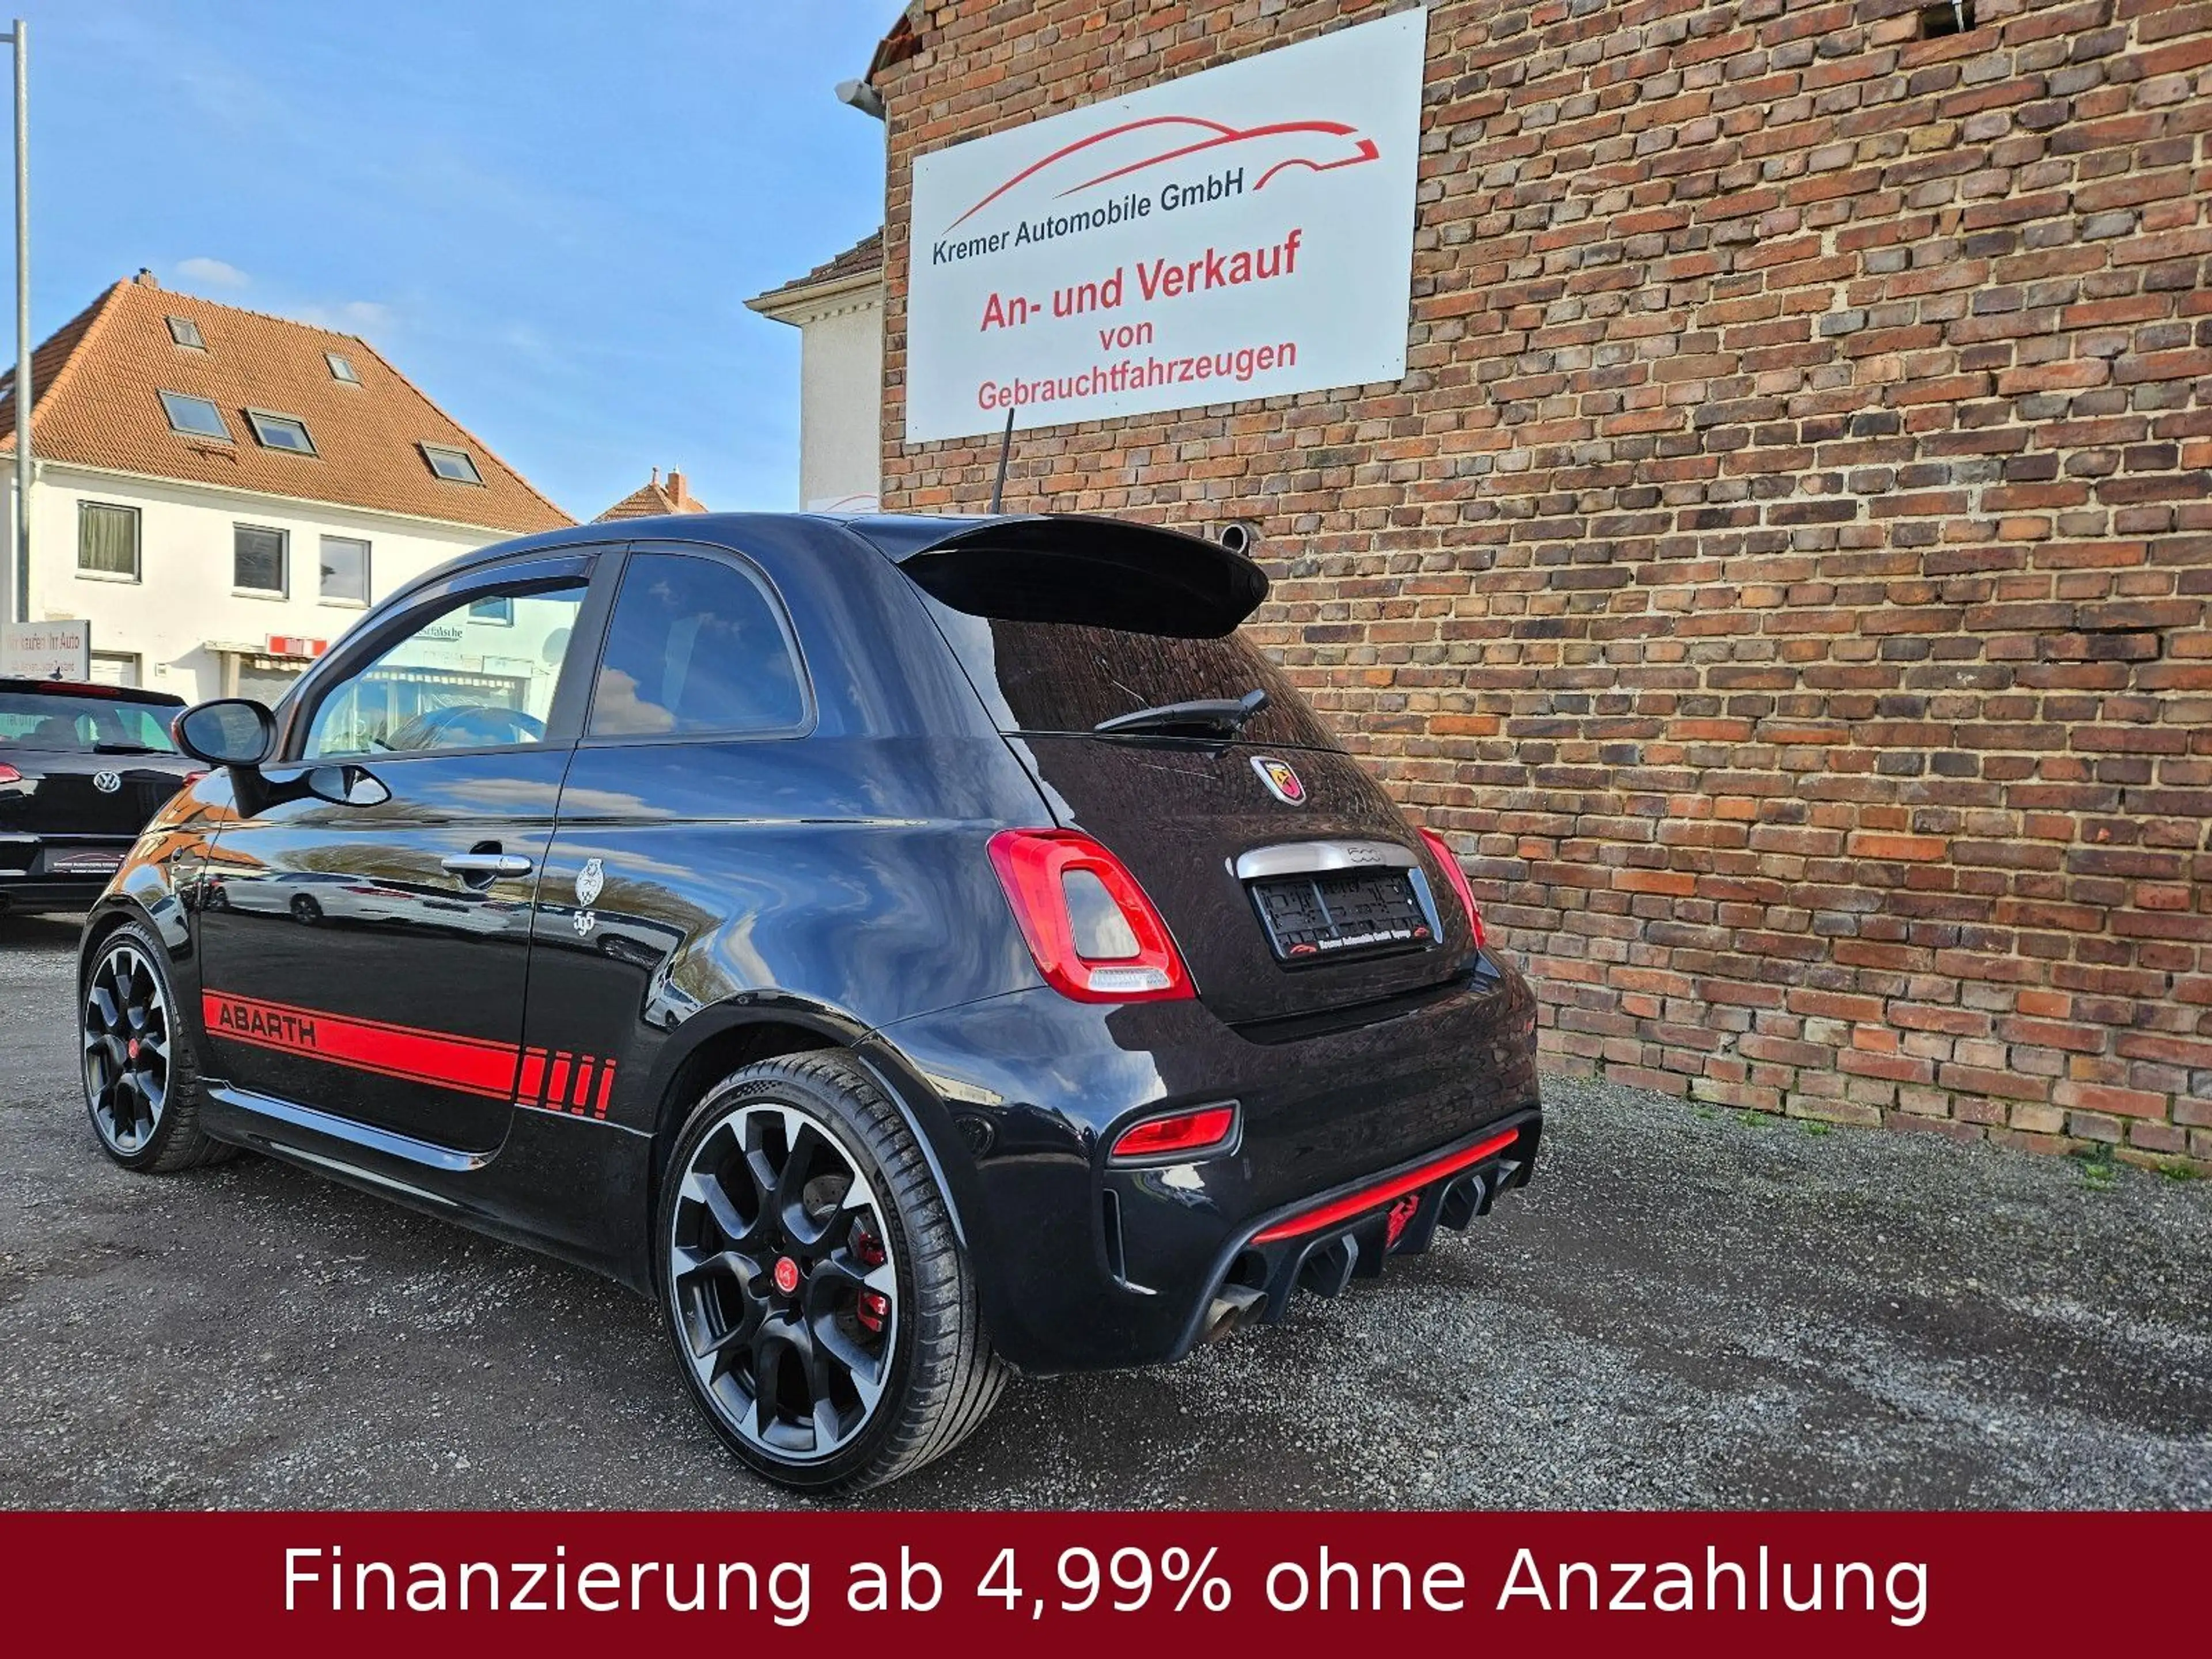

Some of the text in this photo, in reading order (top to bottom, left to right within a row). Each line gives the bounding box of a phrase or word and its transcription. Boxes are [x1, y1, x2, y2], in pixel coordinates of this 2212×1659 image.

[933, 167, 1244, 265] Kremer Automobile GmbH
[980, 228, 1302, 331] An- und Verkauf
[1099, 321, 1153, 350] von
[978, 342, 1297, 410] Gebrauchtfahrzeugen
[60, 631, 80, 650] Auto
[573, 911, 596, 937] 595
[219, 1002, 316, 1048] ABARTH
